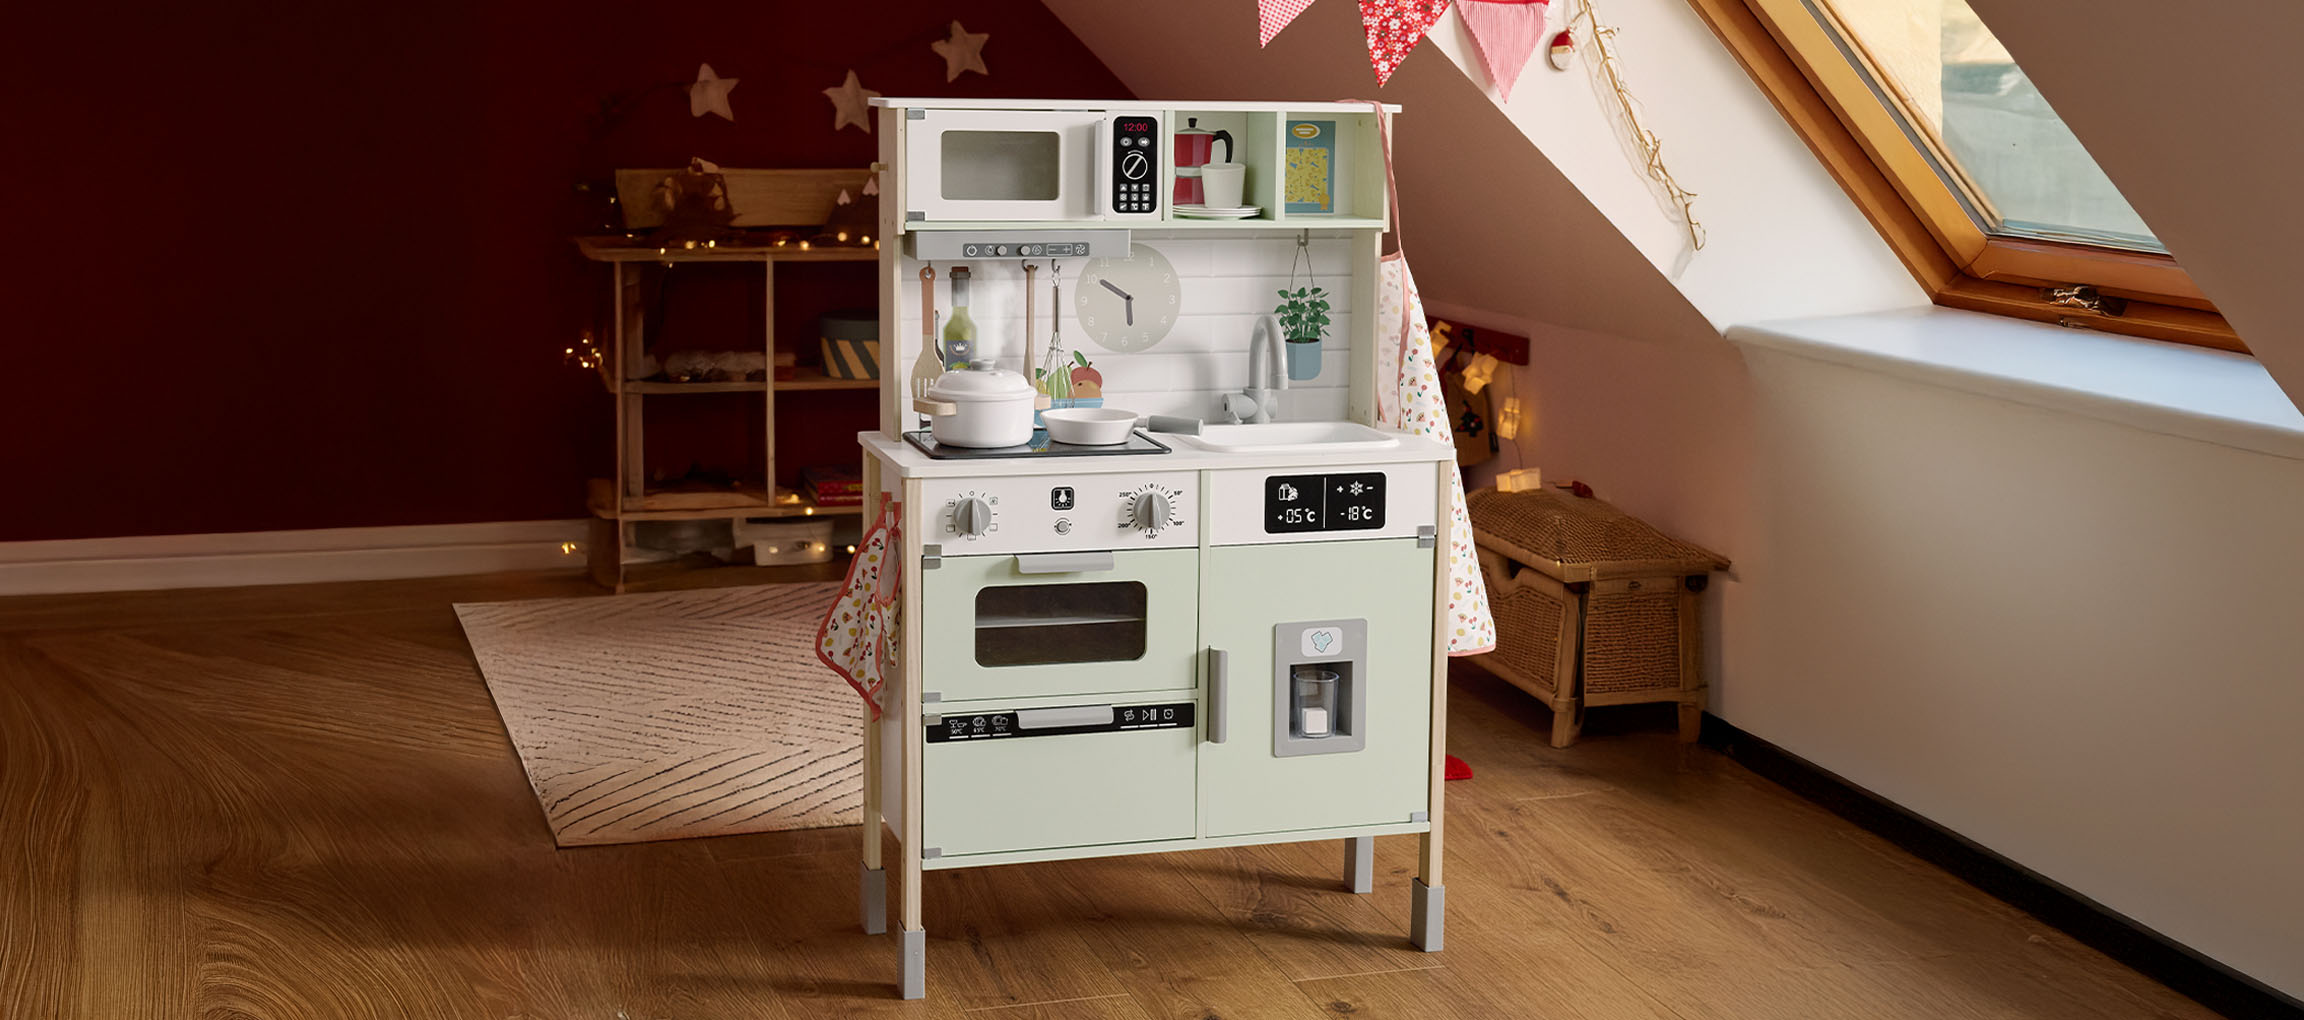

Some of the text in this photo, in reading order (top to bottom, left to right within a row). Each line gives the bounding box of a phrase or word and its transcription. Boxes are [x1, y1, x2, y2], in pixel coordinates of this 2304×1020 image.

[1124, 122, 1148, 132] 12:00
[1087, 273, 1098, 285] 10
[1163, 273, 1171, 283] 2
[1080, 296, 1088, 306] 9
[1168, 295, 1176, 305] 3
[1087, 316, 1095, 327] 8
[1160, 315, 1168, 325] 4
[1101, 332, 1109, 342] 7
[1121, 336, 1128, 346] 6
[1143, 332, 1152, 342] 5
